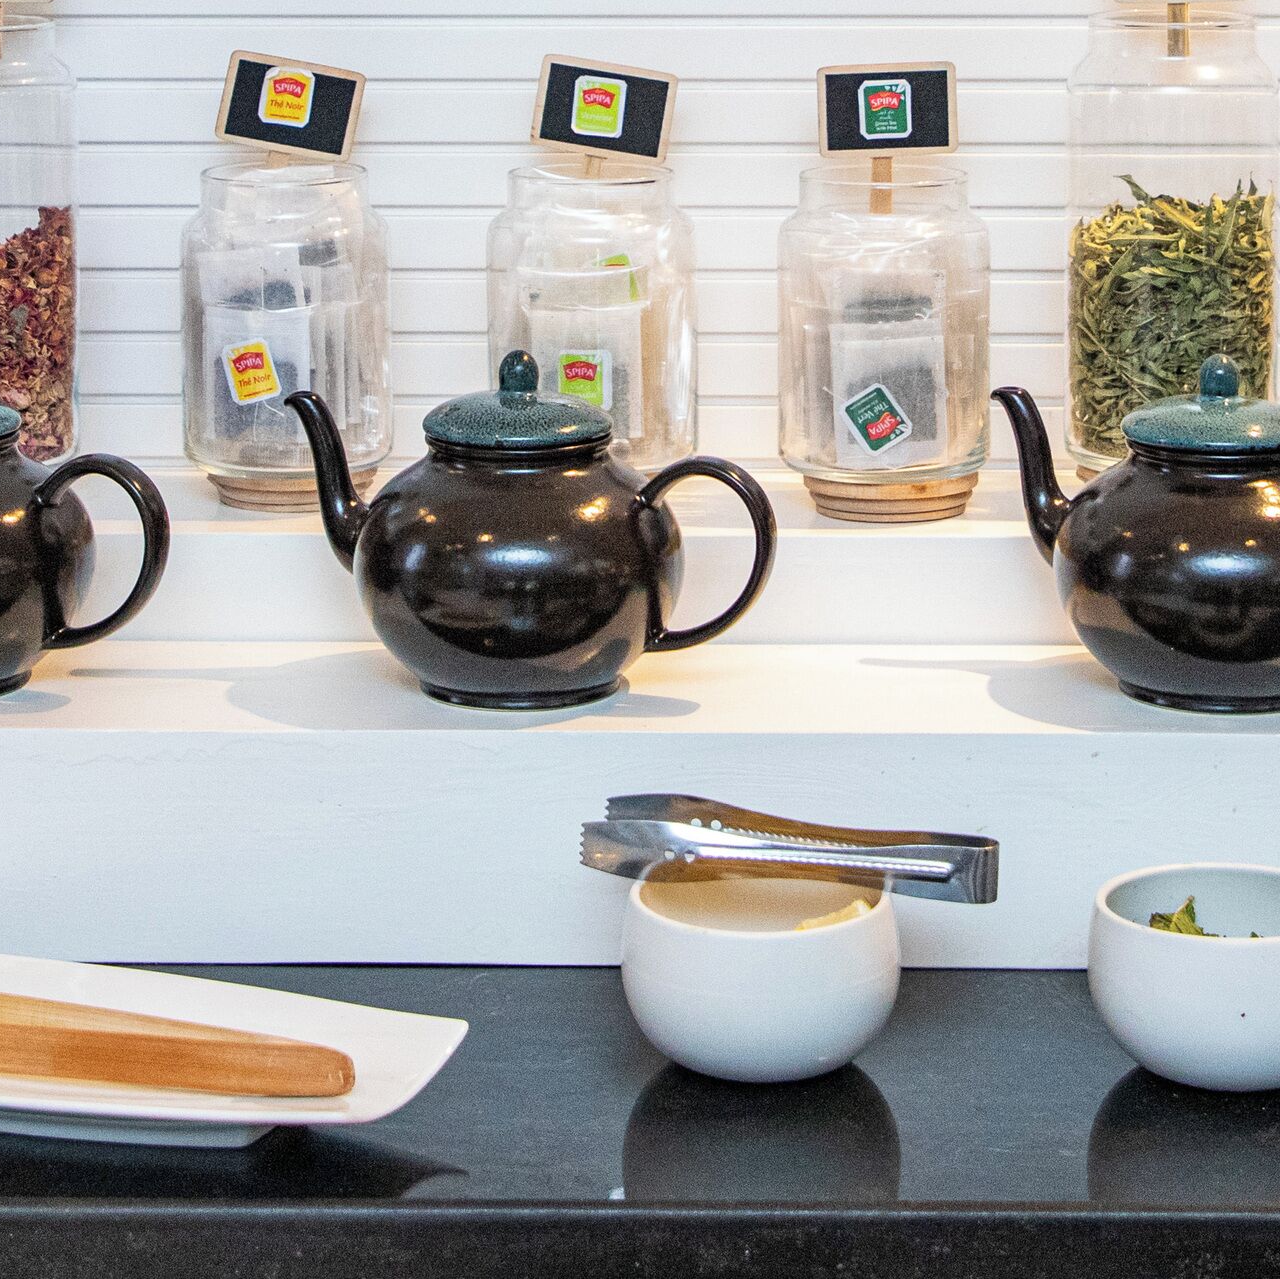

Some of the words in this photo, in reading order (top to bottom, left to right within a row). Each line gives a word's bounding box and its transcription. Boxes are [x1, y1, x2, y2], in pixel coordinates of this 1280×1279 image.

[275, 82, 302, 96] SPIPA
[584, 93, 611, 106] SPIPA
[870, 97, 898, 107] SPIPA
[285, 101, 305, 111] Noir
[235, 357, 263, 371] SPIPA
[253, 373, 271, 384] Noir
[566, 367, 595, 378] SPIPA
[868, 416, 896, 435] SPIPA
